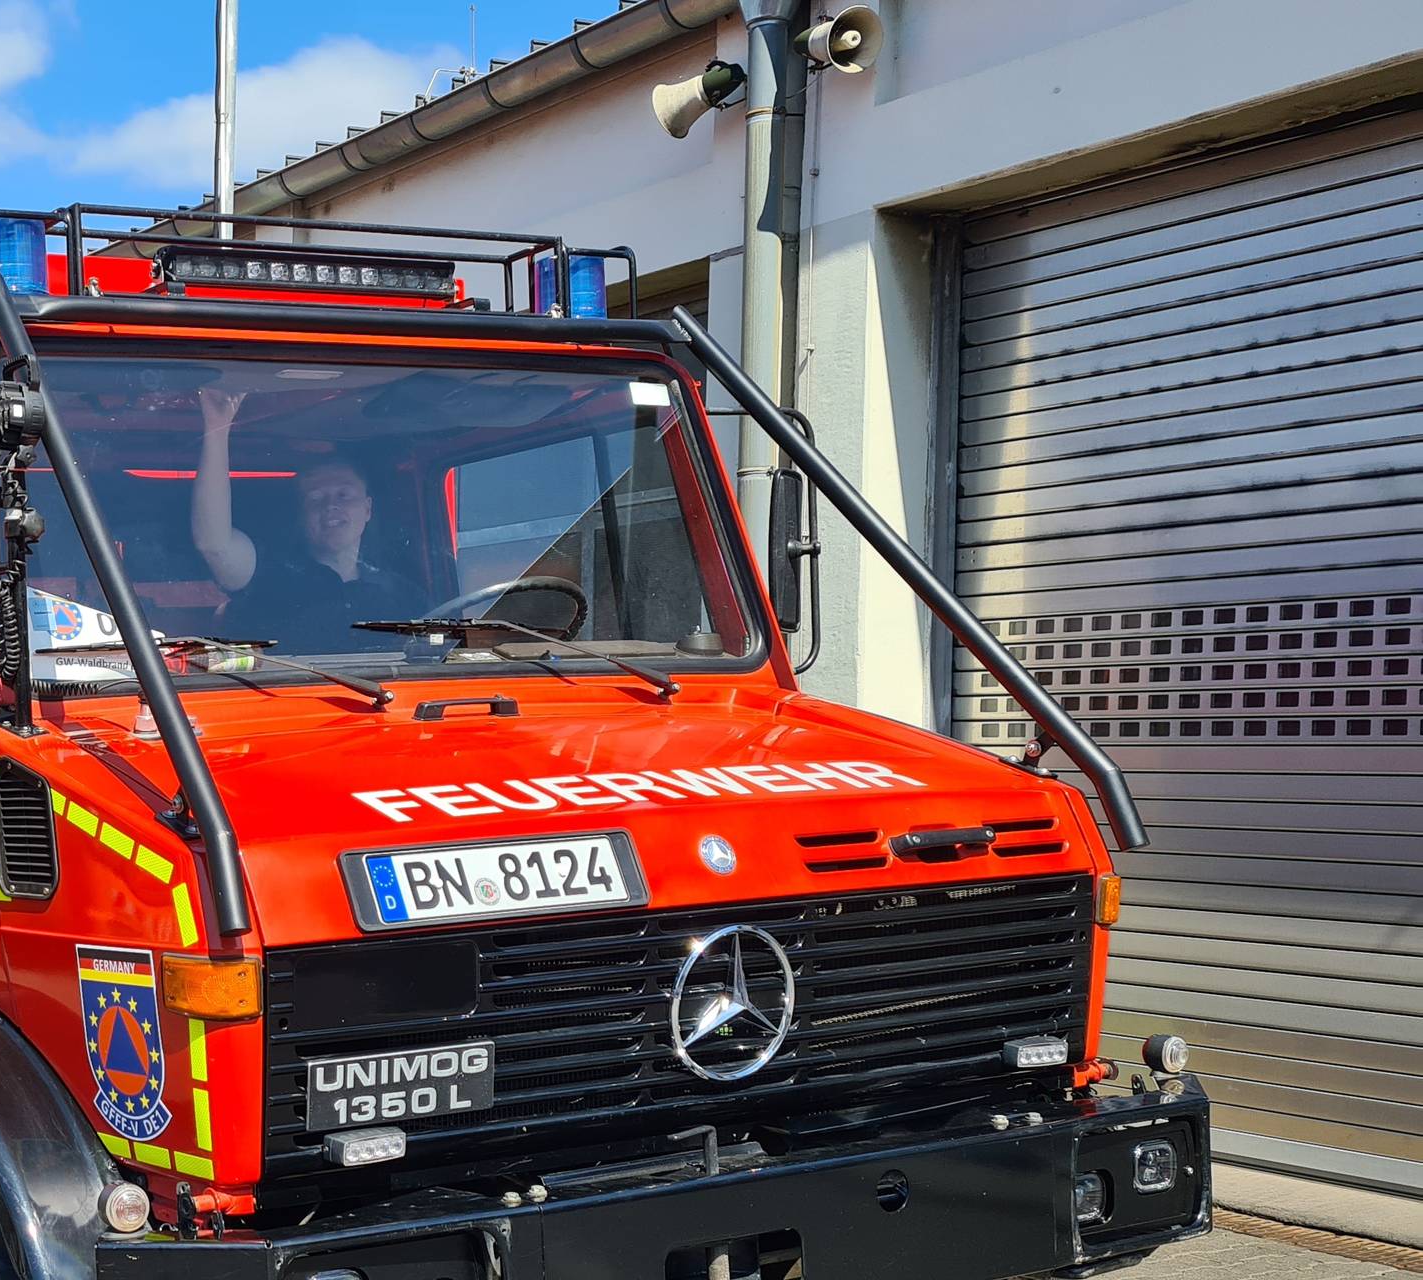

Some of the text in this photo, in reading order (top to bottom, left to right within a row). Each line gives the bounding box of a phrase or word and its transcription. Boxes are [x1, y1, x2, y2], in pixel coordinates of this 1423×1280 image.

[55, 656, 129, 671] GW-Waldbrand
[350, 761, 927, 823] FEUERWEHR
[403, 846, 613, 911] BN 8124
[387, 895, 396, 910] D
[93, 958, 136, 975] GERMANY
[316, 1048, 488, 1092] UNIMOG
[100, 1099, 165, 1137] GFFF-V DE1
[334, 1085, 472, 1125] 1350 L
